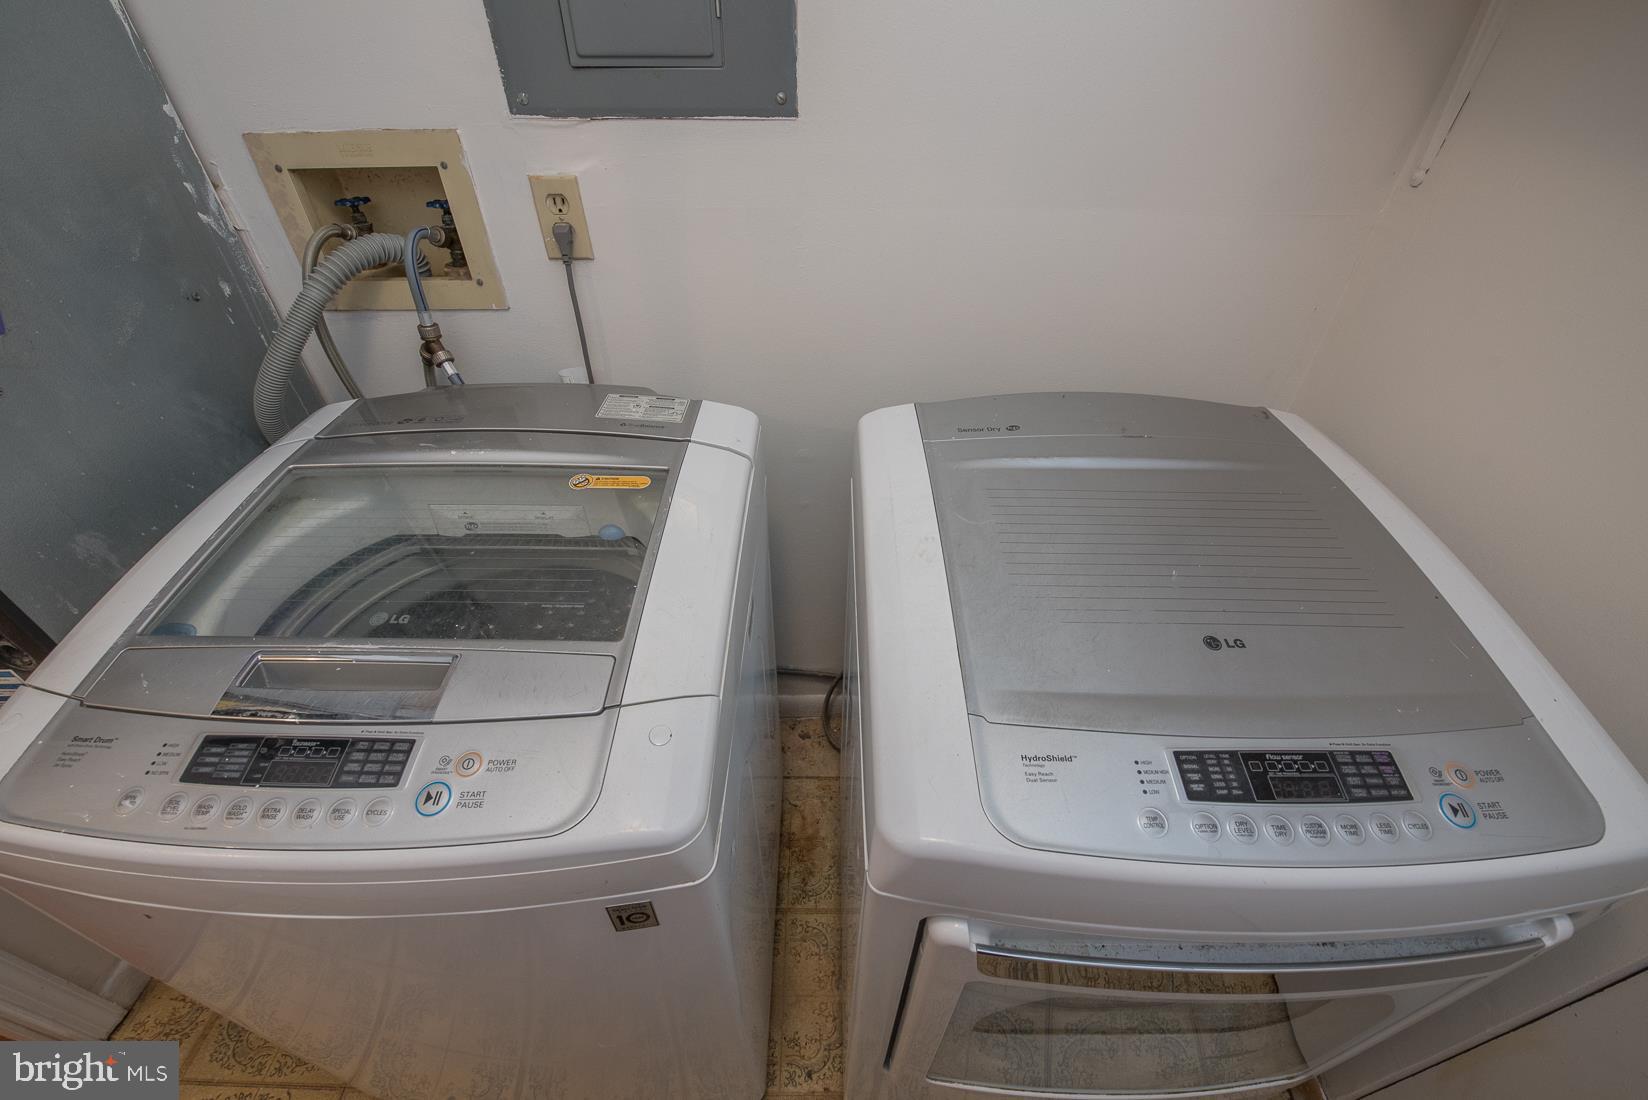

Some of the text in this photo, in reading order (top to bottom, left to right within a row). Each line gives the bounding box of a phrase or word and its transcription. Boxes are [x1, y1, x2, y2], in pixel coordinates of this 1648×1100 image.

[389, 614, 411, 624] LG
[1223, 638, 1247, 649] LG
[71, 735, 94, 744] Smart
[459, 790, 487, 799] START
[456, 801, 485, 809] PAUSE
[1477, 801, 1502, 810] START
[1407, 823, 1429, 831] CYCLES
[1274, 830, 1288, 838] DRY
